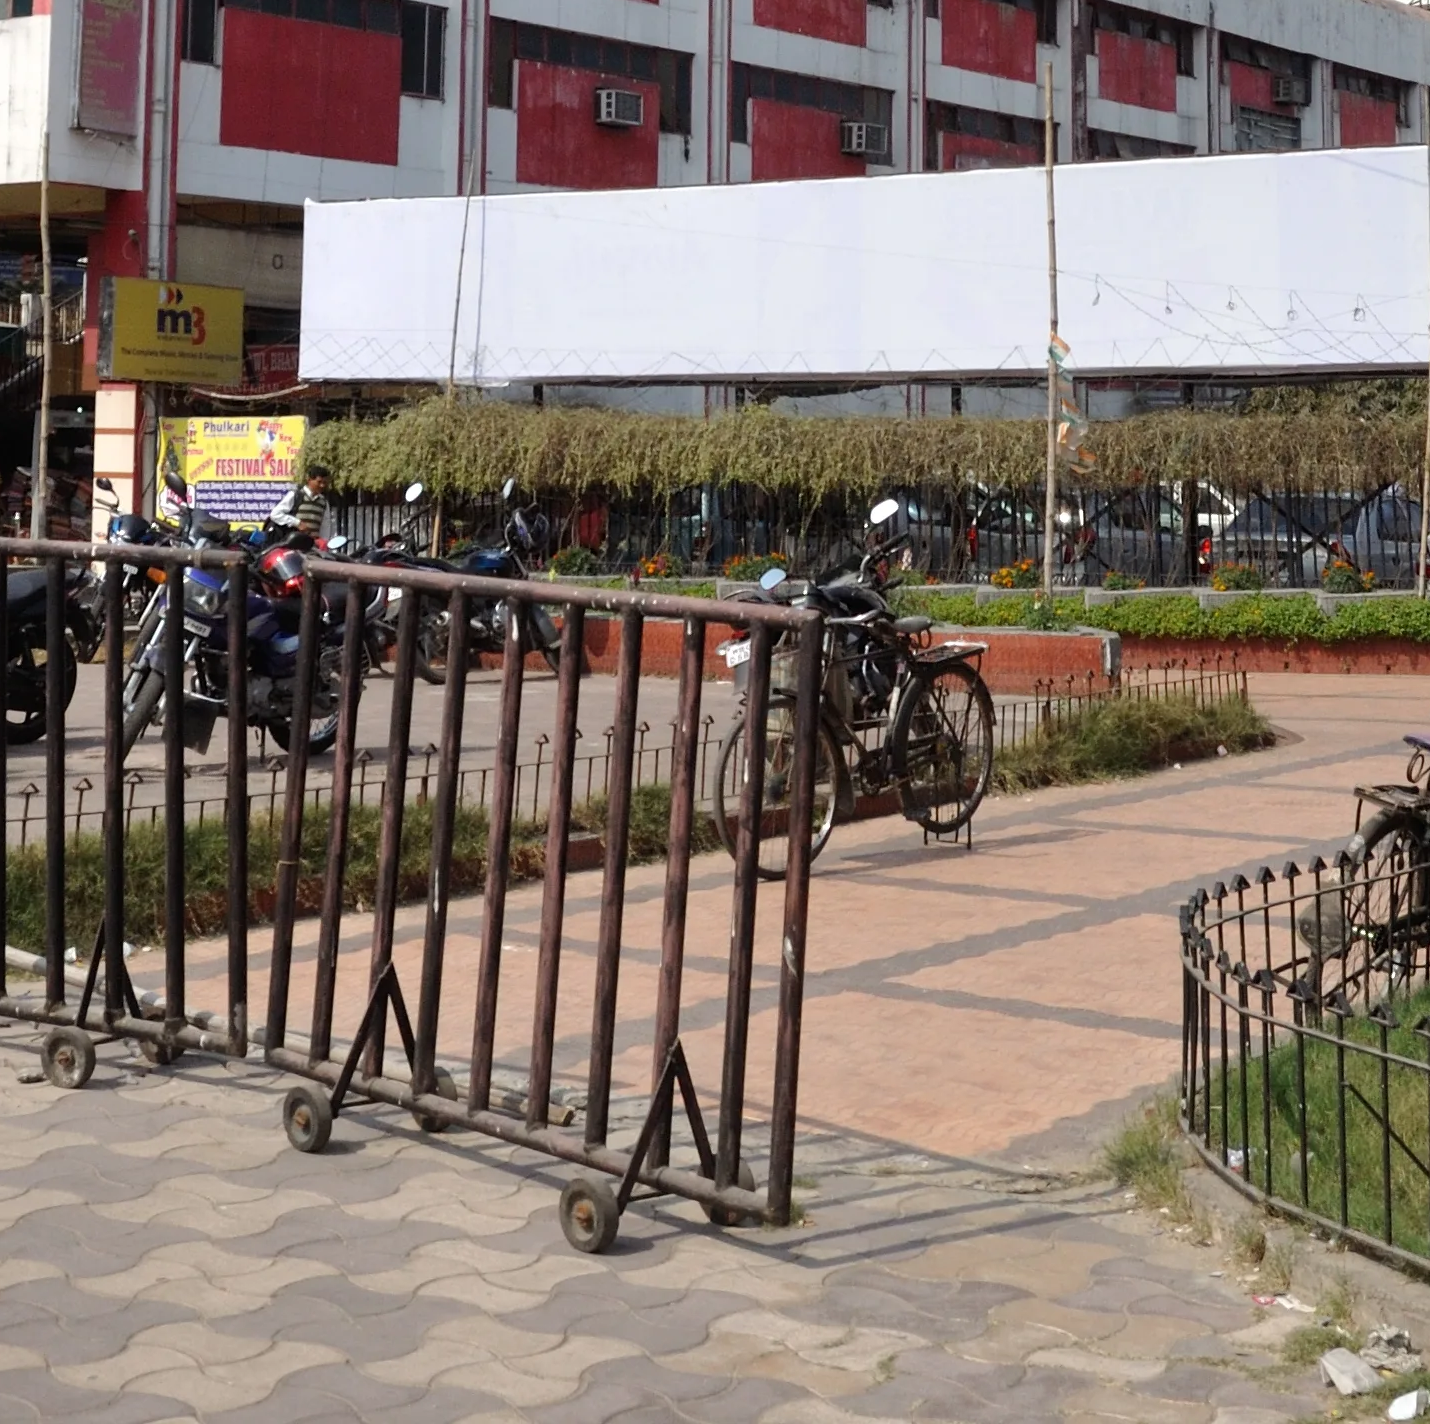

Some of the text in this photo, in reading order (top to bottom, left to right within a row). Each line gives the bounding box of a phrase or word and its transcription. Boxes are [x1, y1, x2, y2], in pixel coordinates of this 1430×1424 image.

[156, 306, 206, 345] m3
[203, 421, 249, 432] Phulkari
[216, 458, 266, 477] FESTIVAL
